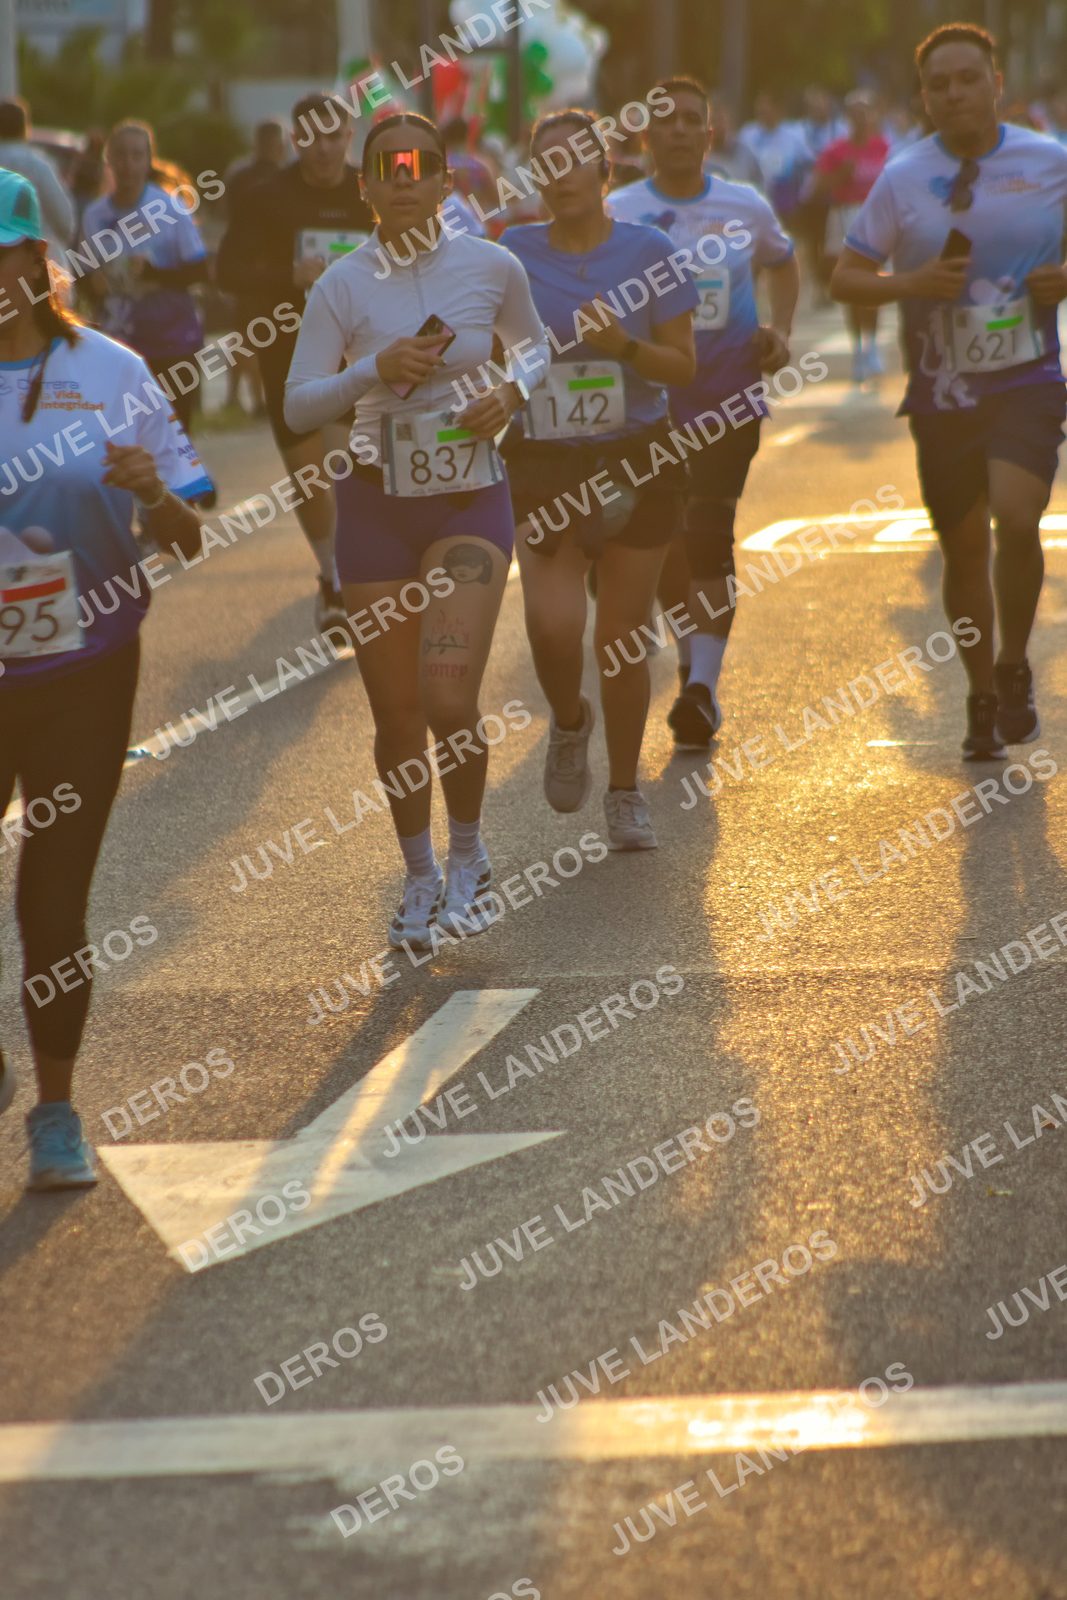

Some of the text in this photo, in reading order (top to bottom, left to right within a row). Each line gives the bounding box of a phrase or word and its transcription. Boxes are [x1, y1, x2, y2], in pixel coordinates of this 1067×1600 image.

[695, 291, 718, 320] 5
[966, 330, 1016, 364] 621
[547, 393, 611, 428] 142
[410, 442, 478, 485] 837
